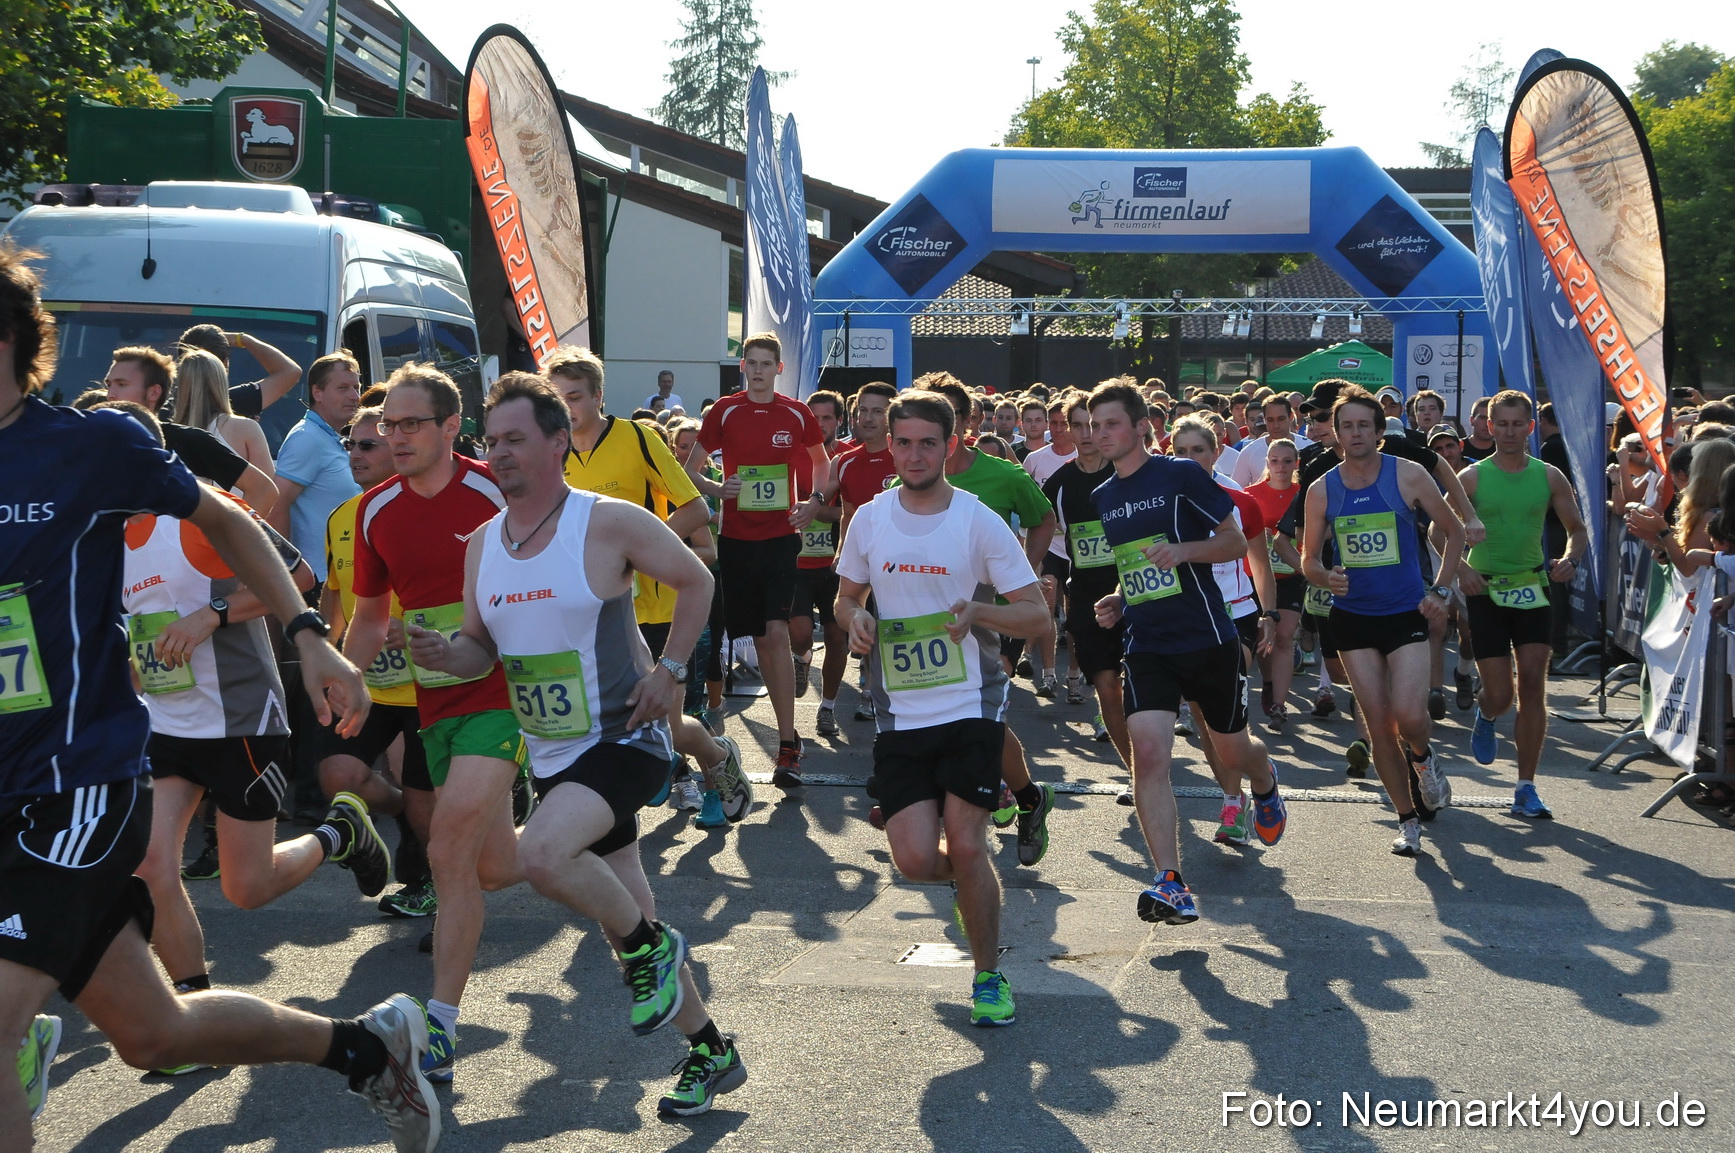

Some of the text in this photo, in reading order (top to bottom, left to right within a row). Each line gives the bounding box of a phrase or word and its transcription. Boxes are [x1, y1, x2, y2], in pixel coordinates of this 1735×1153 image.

[253, 161, 284, 174] 1628
[1144, 179, 1184, 187] Fischer
[755, 109, 786, 292] Fischer
[1113, 198, 1232, 220] firmenlauf
[1113, 220, 1162, 229] neumarkt
[890, 237, 953, 251] Fischer
[1376, 236, 1394, 246] das
[752, 481, 776, 500] 19
[1102, 495, 1165, 523] EURO POLES
[805, 532, 833, 548] 349
[1077, 535, 1113, 557] 973
[1346, 531, 1388, 554] 589
[899, 564, 951, 576] KLEBL
[132, 574, 165, 593] KLEBL
[1123, 567, 1175, 597] 5088
[506, 588, 557, 604] KLEBL
[1497, 587, 1536, 605] 729
[892, 638, 949, 673] 510
[515, 683, 572, 718] 513
